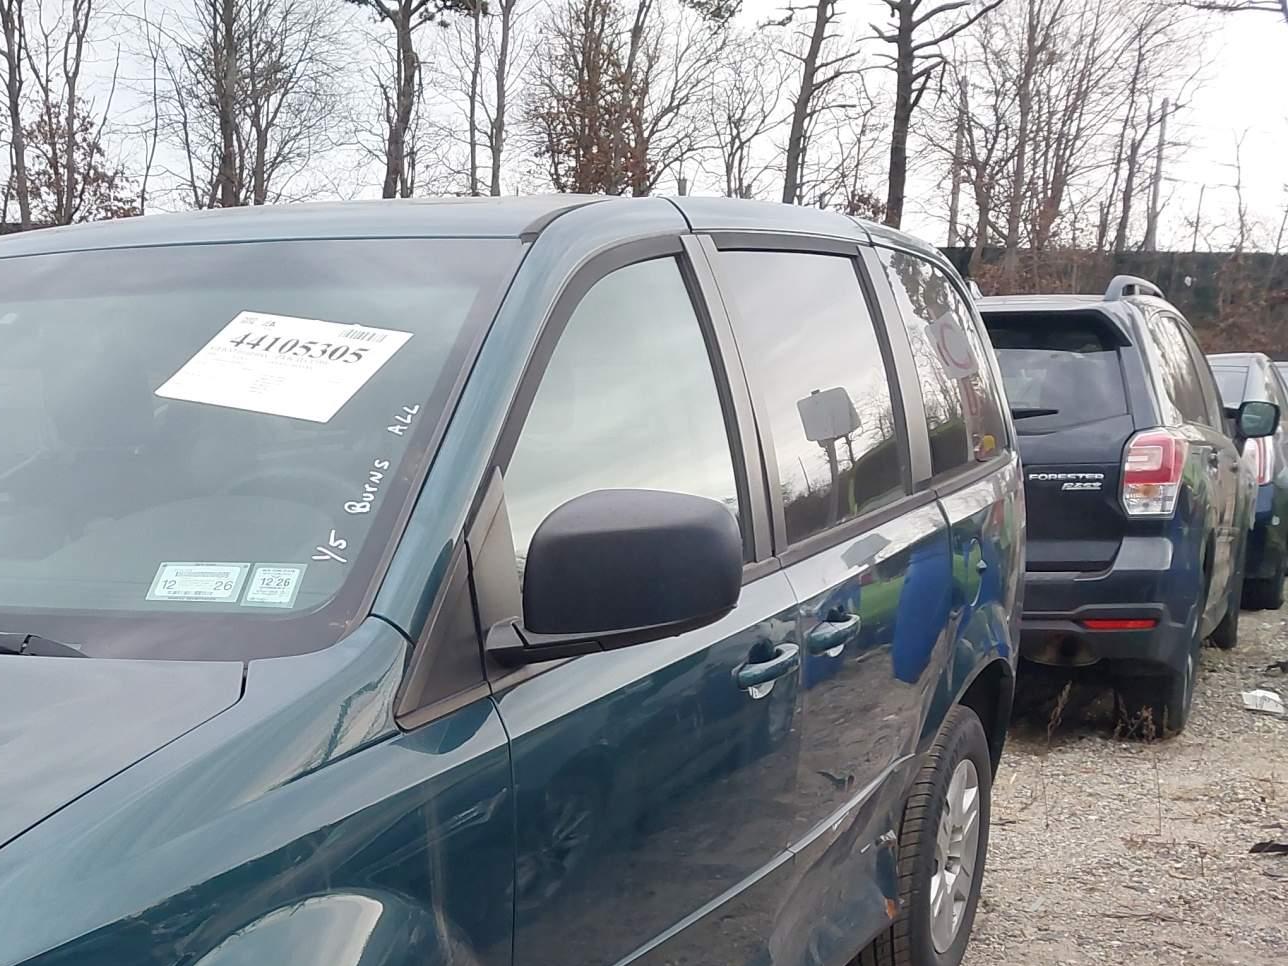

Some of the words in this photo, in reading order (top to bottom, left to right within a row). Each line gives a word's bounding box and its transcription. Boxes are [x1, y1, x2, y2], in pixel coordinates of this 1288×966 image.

[229, 331, 369, 364] 44105305
[387, 403, 420, 436] ALL
[162, 579, 177, 590] 12
[213, 580, 233, 591] 26
